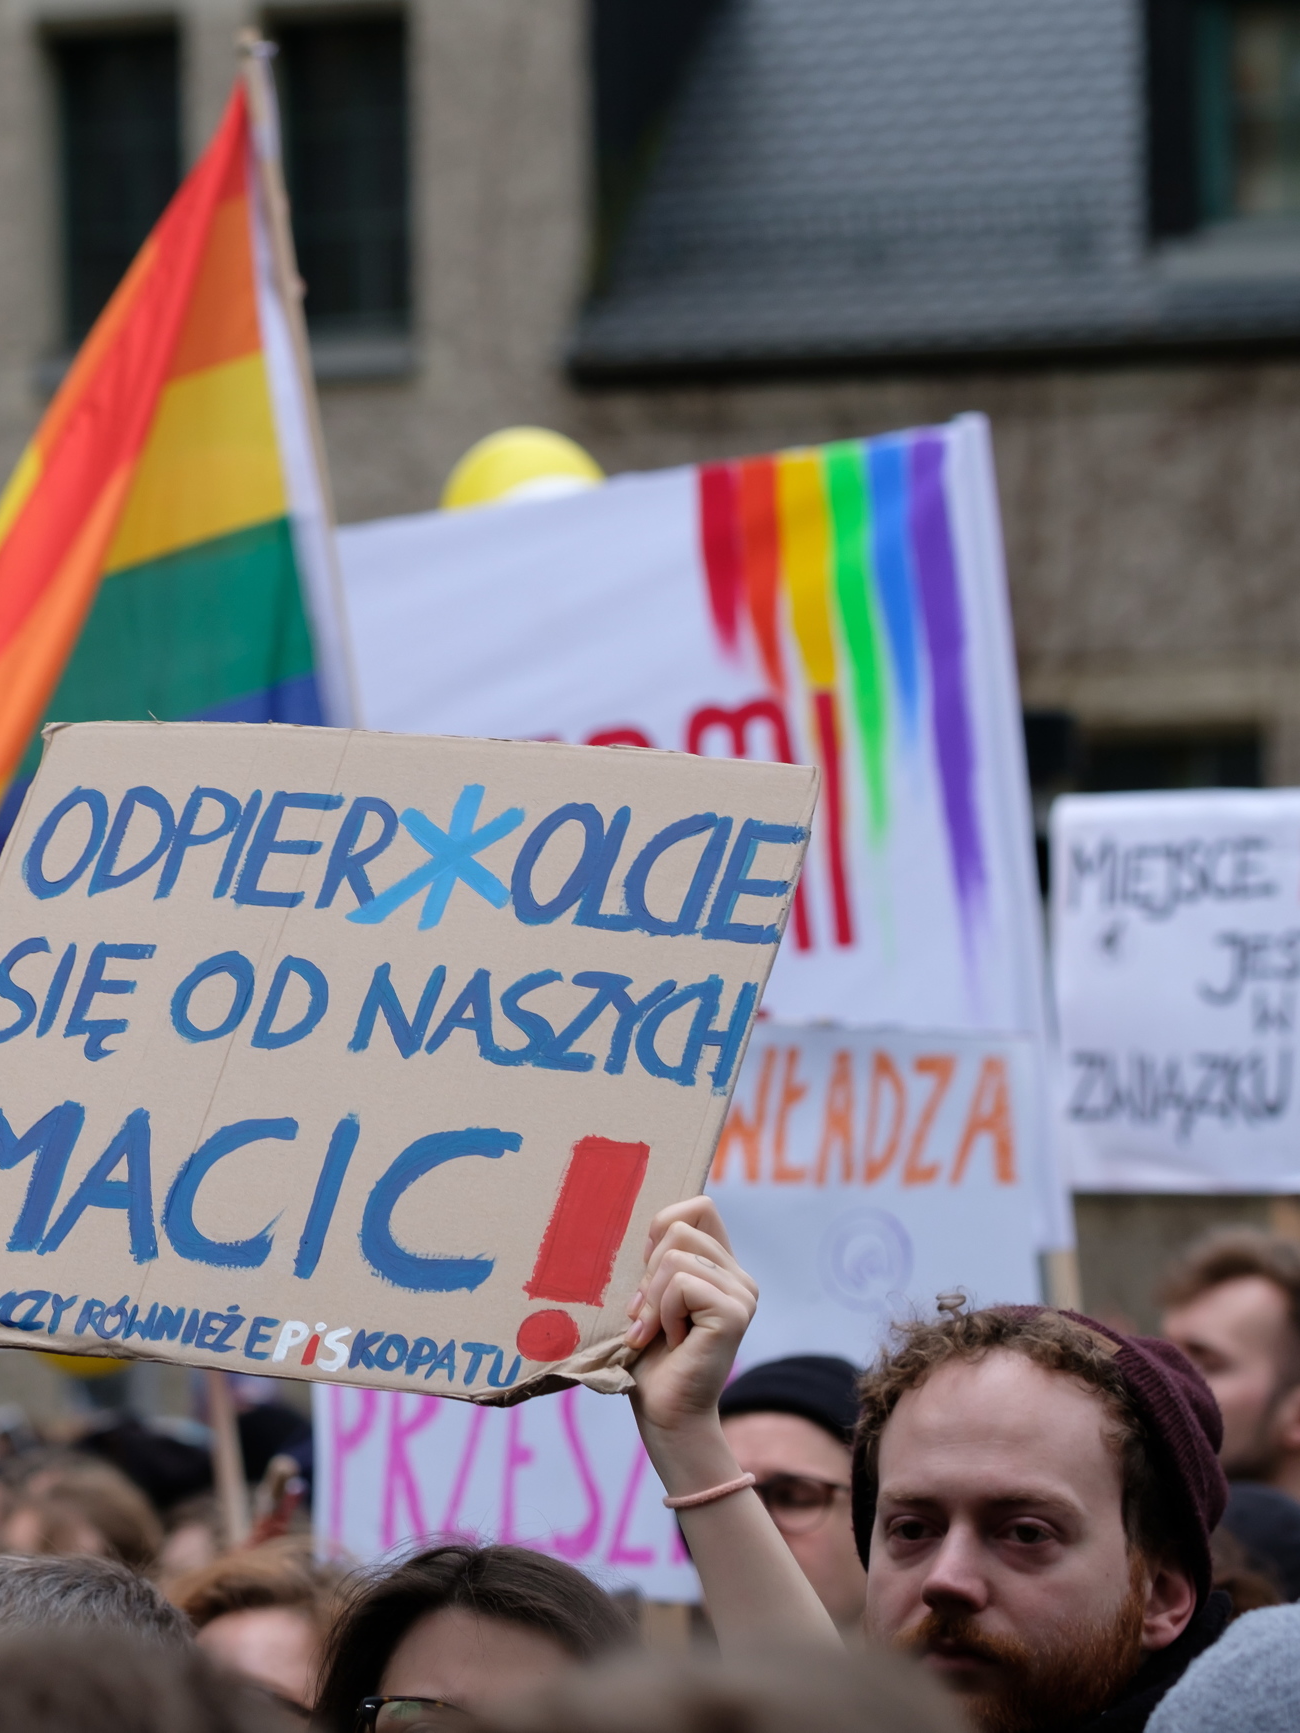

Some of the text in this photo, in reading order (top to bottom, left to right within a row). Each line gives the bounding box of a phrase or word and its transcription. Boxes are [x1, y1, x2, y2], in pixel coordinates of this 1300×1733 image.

[170, 951, 329, 1050] OD
[347, 962, 759, 1097] NASZYCH
[74, 1294, 246, 1352] RÓWNIEŻ
